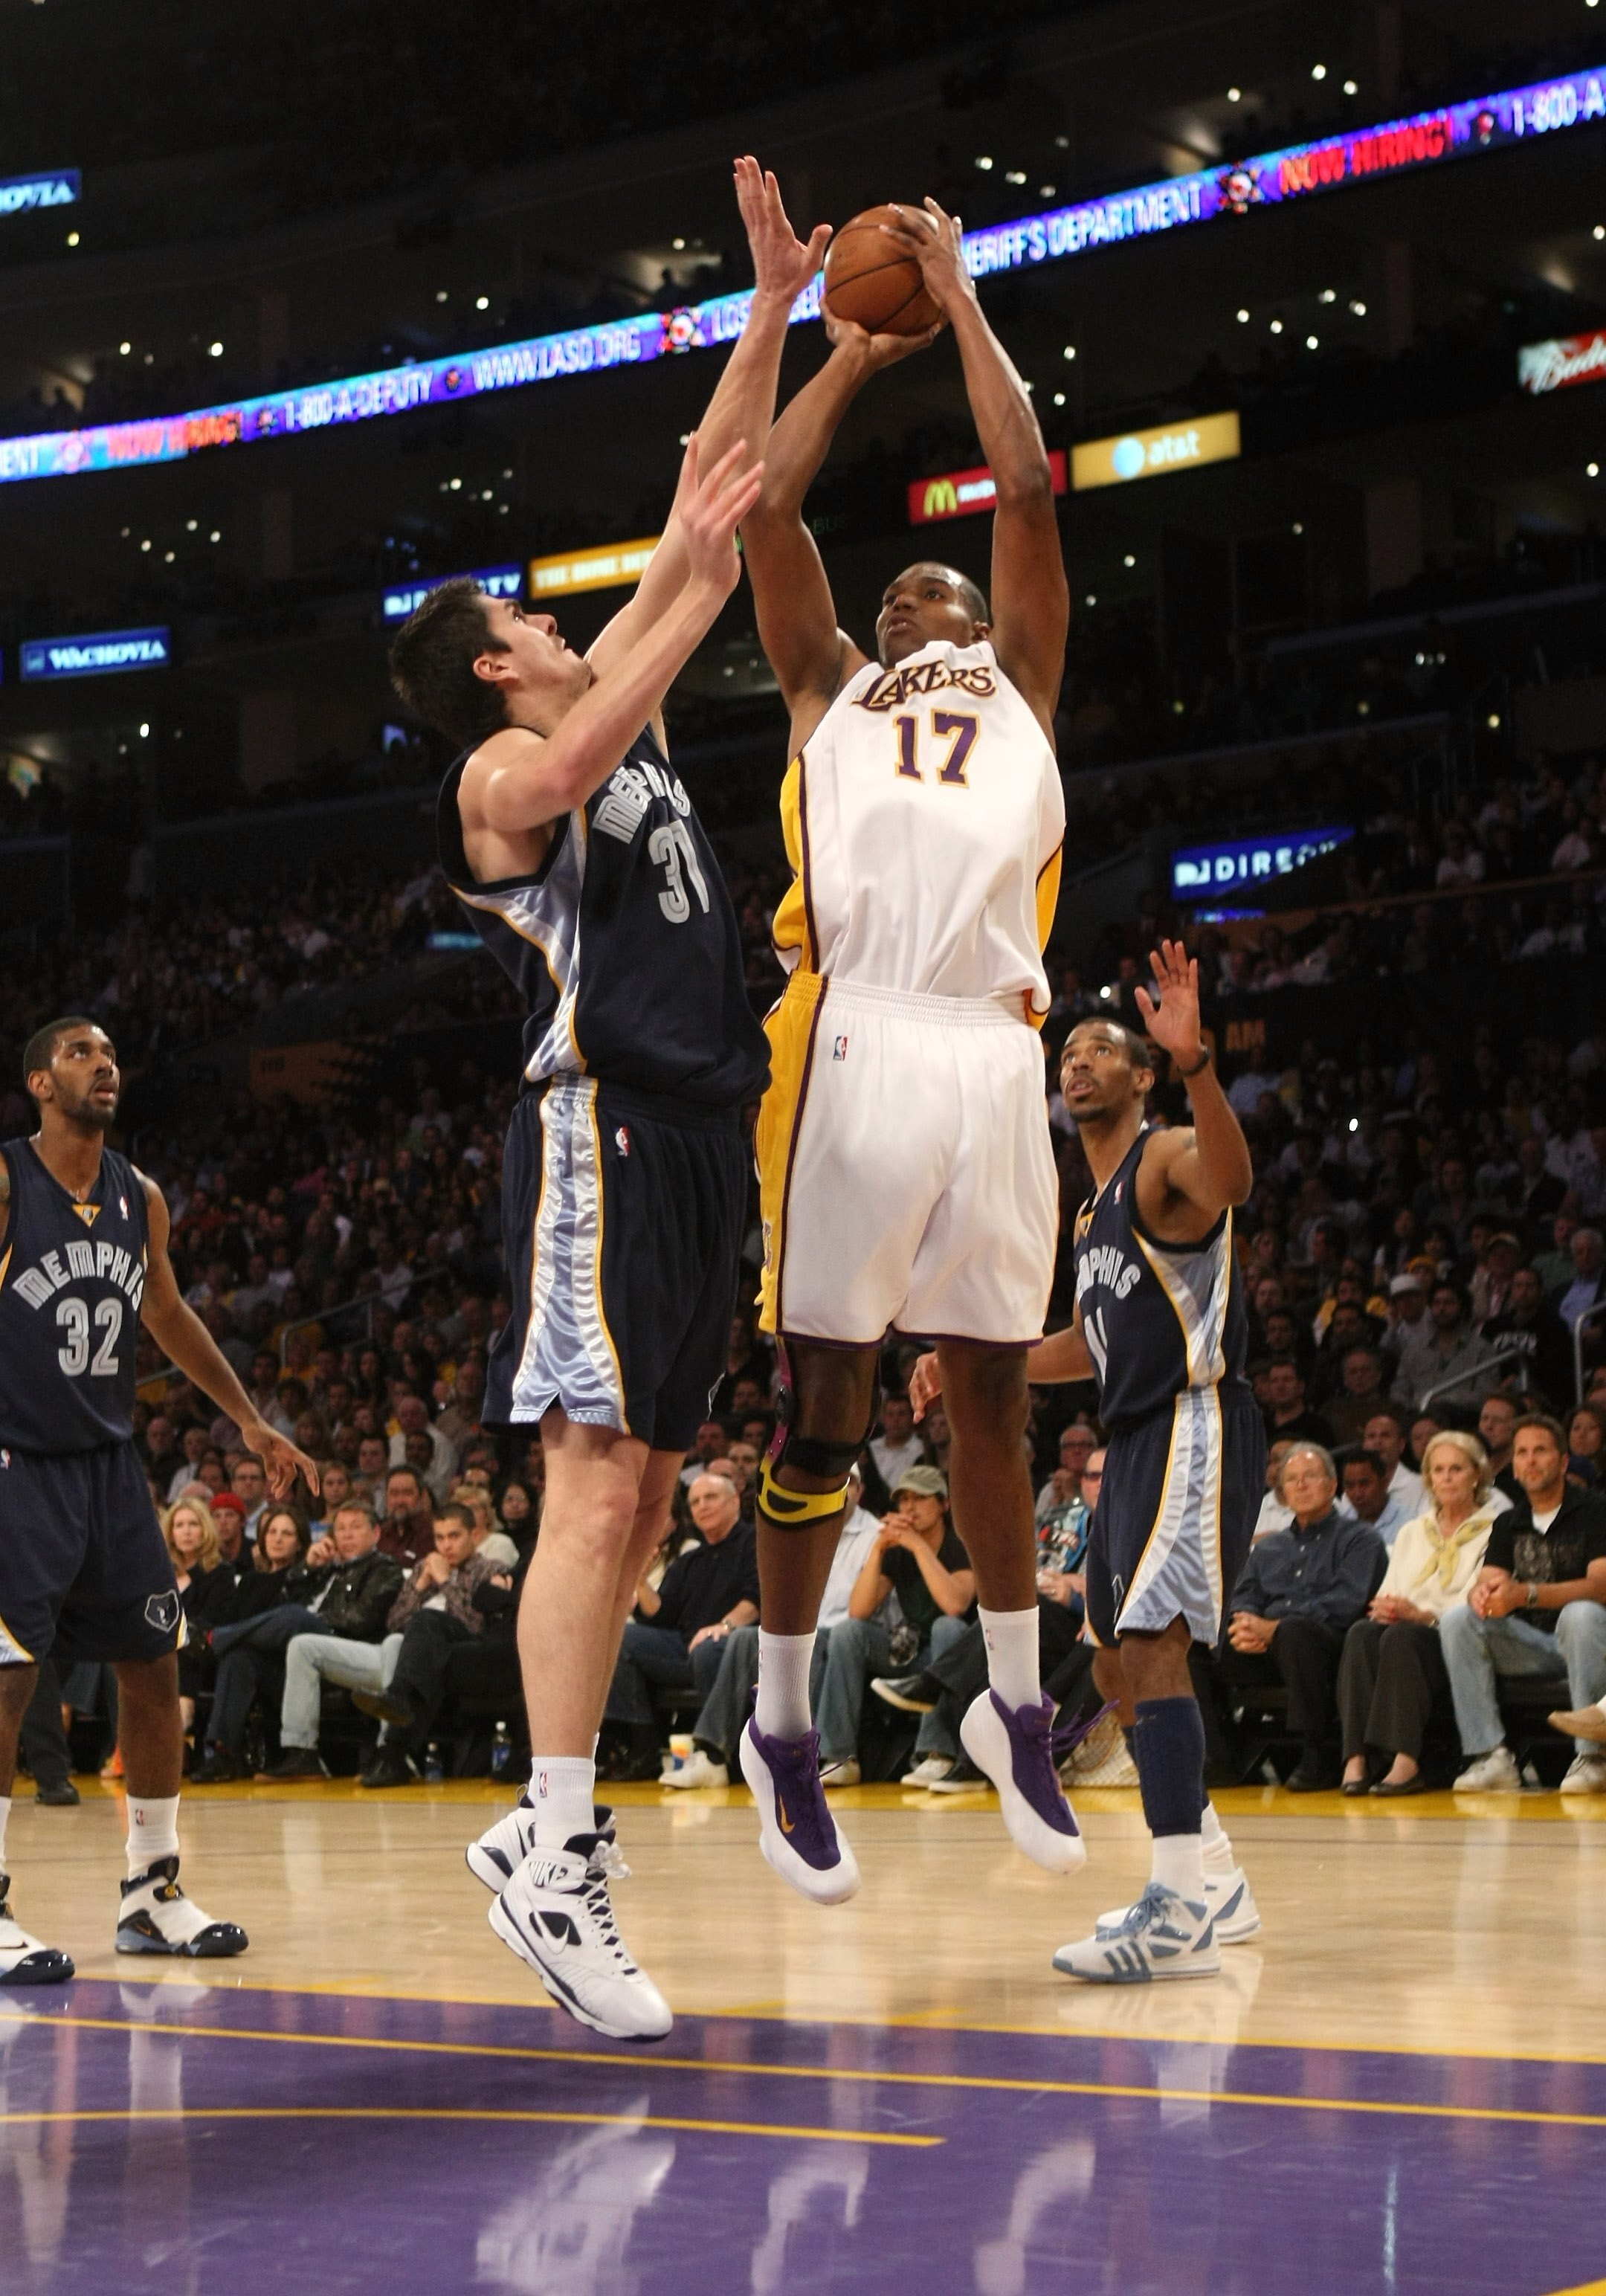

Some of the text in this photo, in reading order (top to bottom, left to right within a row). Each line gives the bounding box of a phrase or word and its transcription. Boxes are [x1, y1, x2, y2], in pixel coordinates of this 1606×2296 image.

[0, 181, 75, 213] OVIA
[1279, 147, 1345, 194] NOW
[962, 182, 1202, 277] ERIFF'S DEPARTMENT
[285, 367, 434, 430] 1-800-A-DEPUTY
[49, 639, 167, 670] WACHOVIA
[850, 659, 1000, 713] LAKERS
[892, 708, 981, 790] 17
[11, 1239, 144, 1312] MEMPHIS
[56, 1296, 123, 1377] 32
